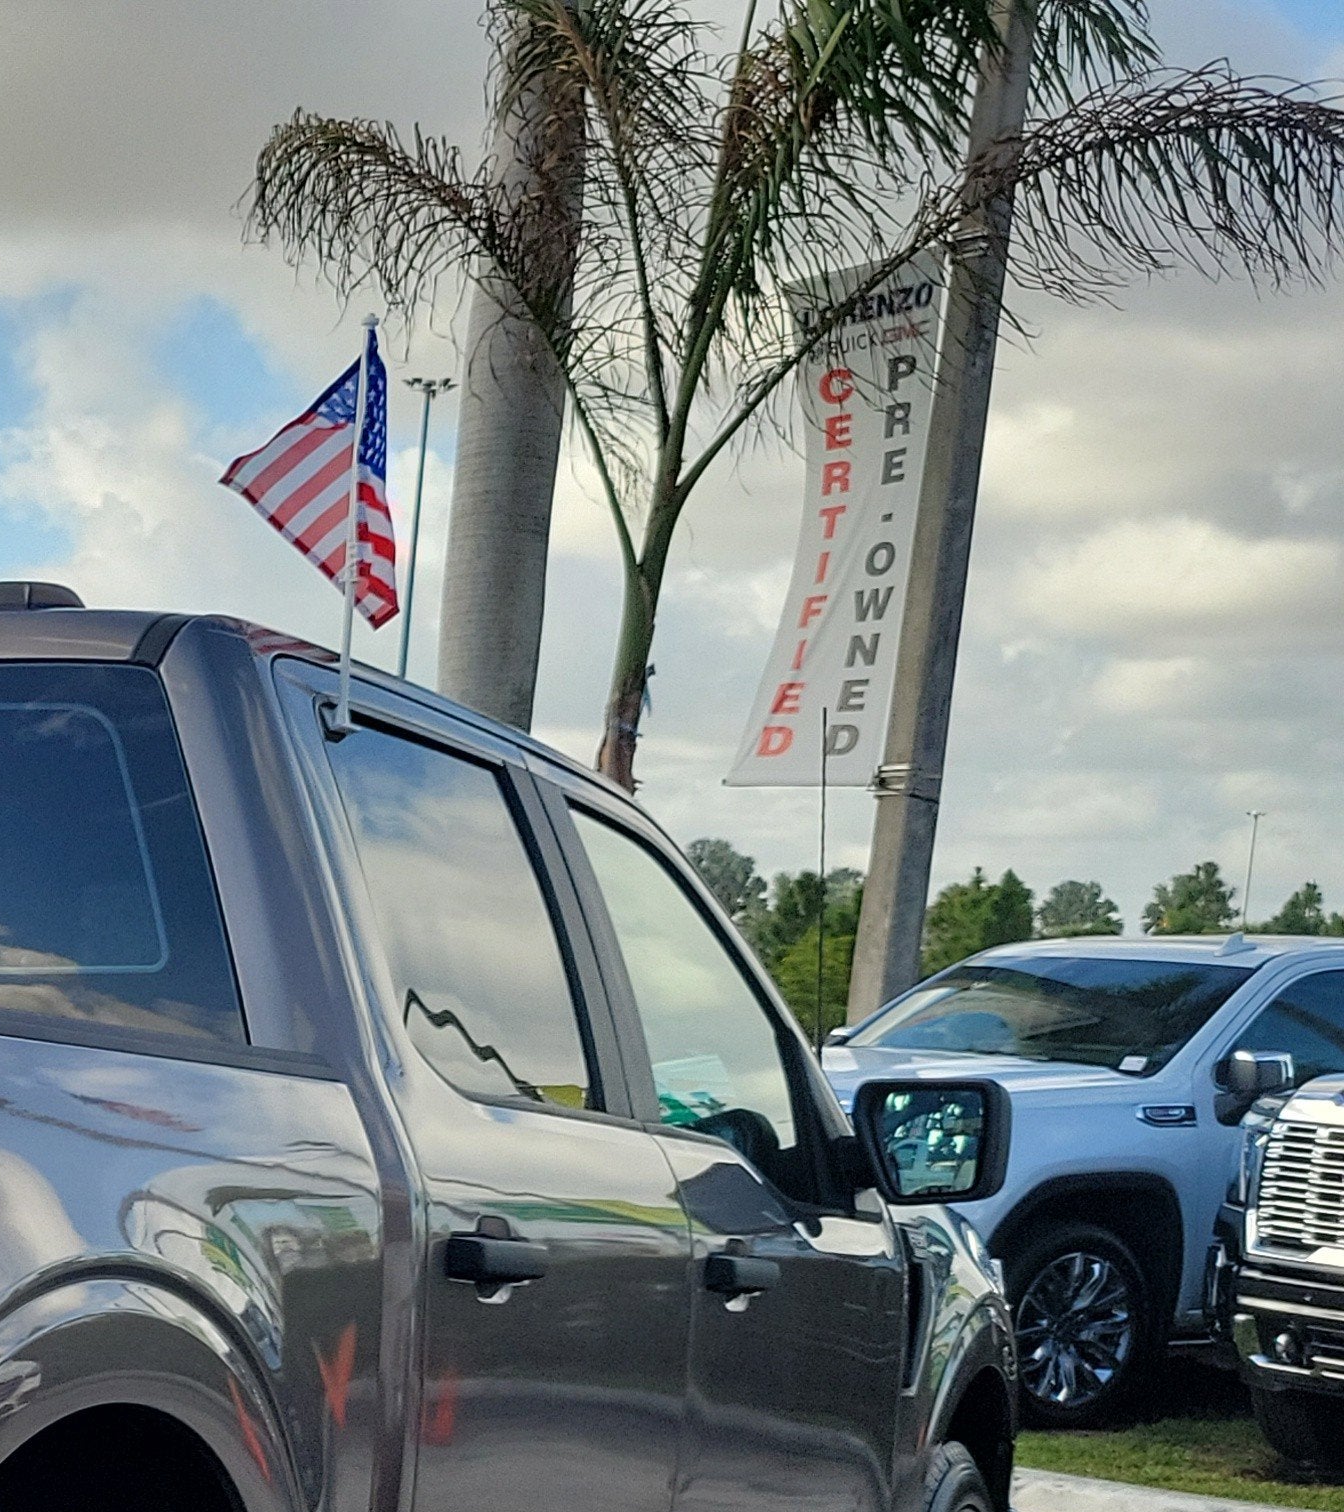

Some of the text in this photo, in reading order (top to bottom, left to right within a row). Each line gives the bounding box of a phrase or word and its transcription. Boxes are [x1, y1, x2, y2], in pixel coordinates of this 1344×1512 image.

[801, 283, 933, 336] LRENZO
[829, 333, 878, 356] UICK
[755, 367, 855, 757] CERTIFIED
